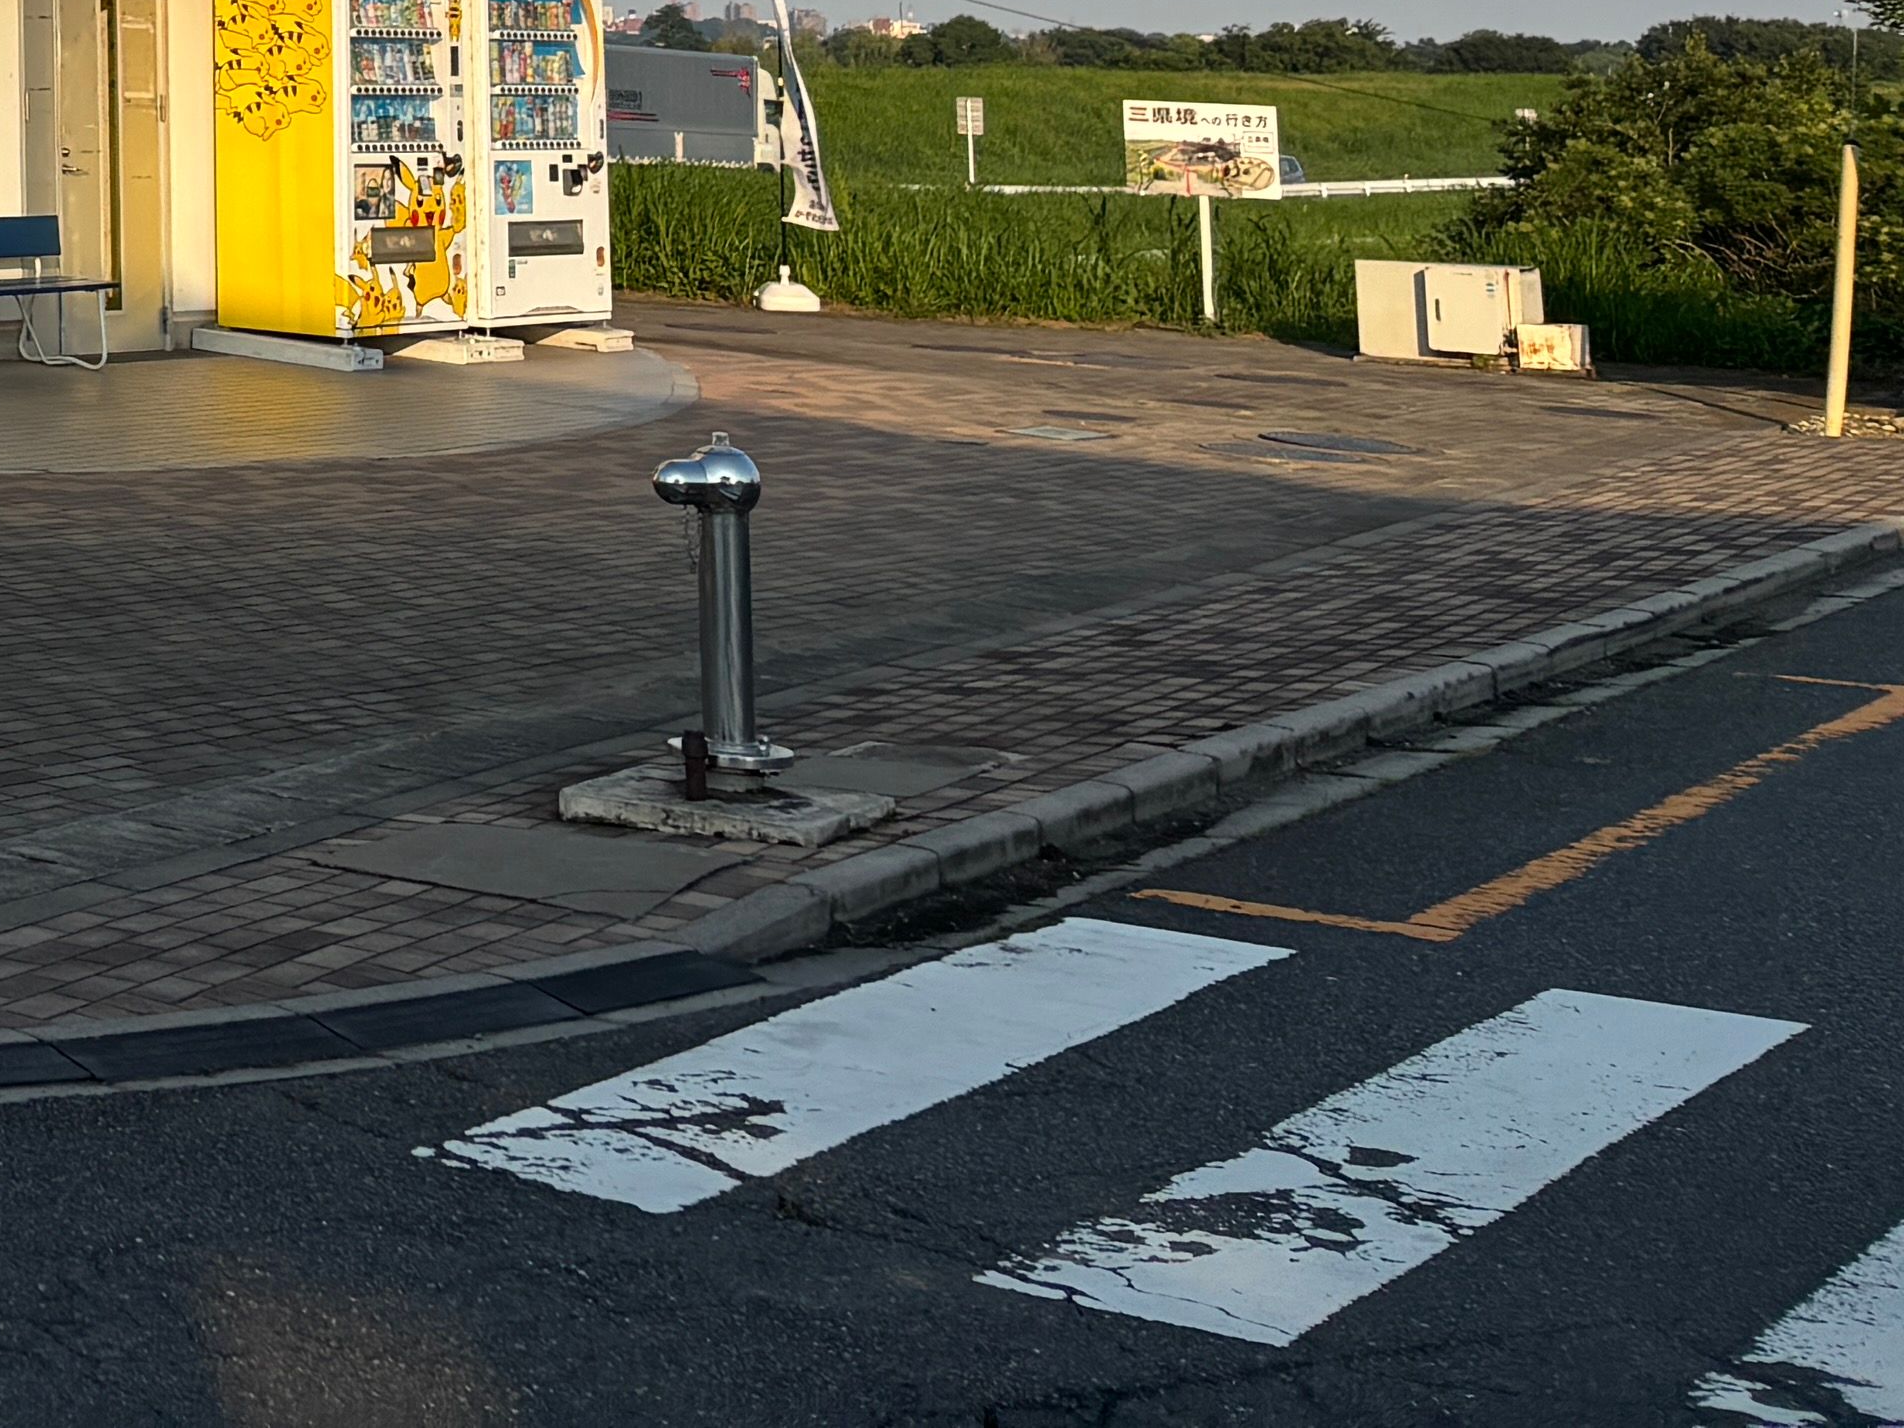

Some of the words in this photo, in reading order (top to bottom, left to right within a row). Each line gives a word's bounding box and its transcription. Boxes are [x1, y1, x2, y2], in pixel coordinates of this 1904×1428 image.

[1128, 106, 1269, 130] 三県境への行き方
